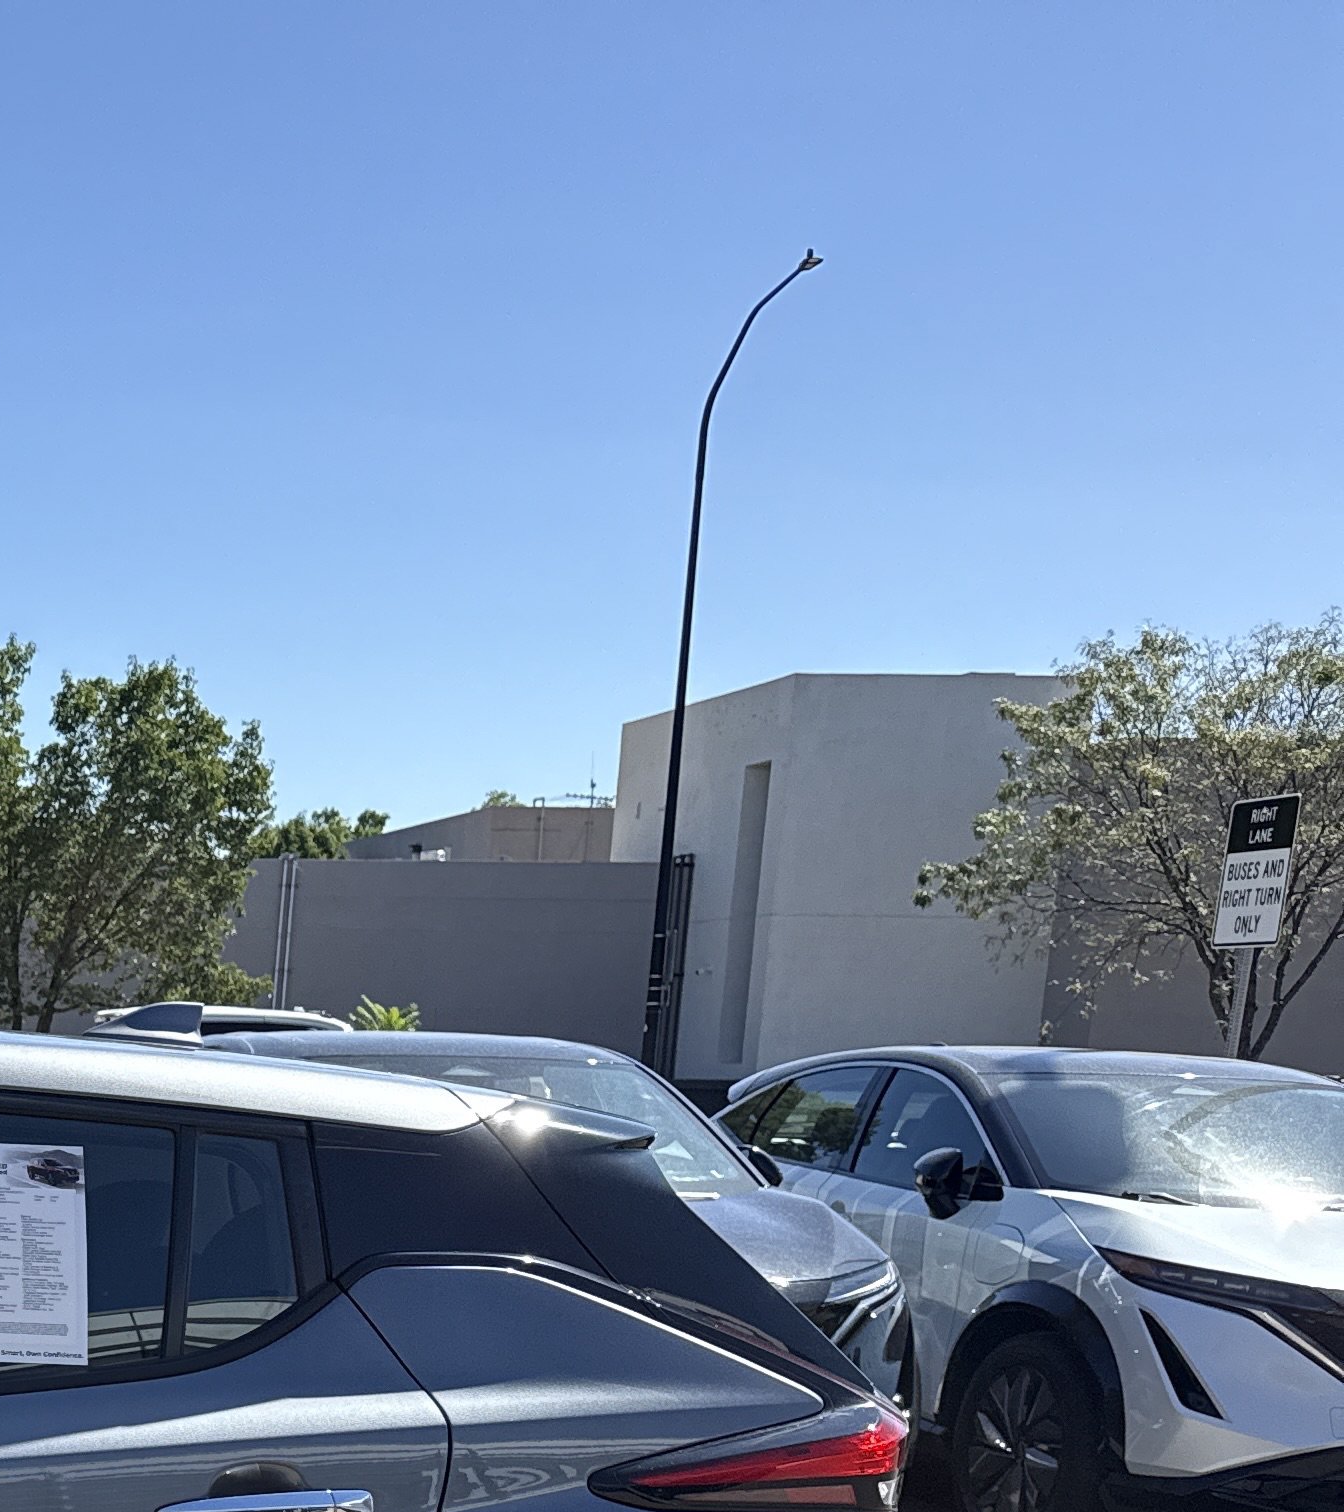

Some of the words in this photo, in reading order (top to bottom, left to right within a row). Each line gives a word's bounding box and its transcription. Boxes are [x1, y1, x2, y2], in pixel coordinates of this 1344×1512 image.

[1250, 805, 1279, 824] RIGHT
[1248, 827, 1275, 845] LANE
[1227, 861, 1260, 882] BUSES
[1262, 858, 1285, 879] AND
[1221, 888, 1251, 909] RIGHT
[1254, 886, 1281, 907] TURN
[1233, 914, 1262, 935] ONLY
